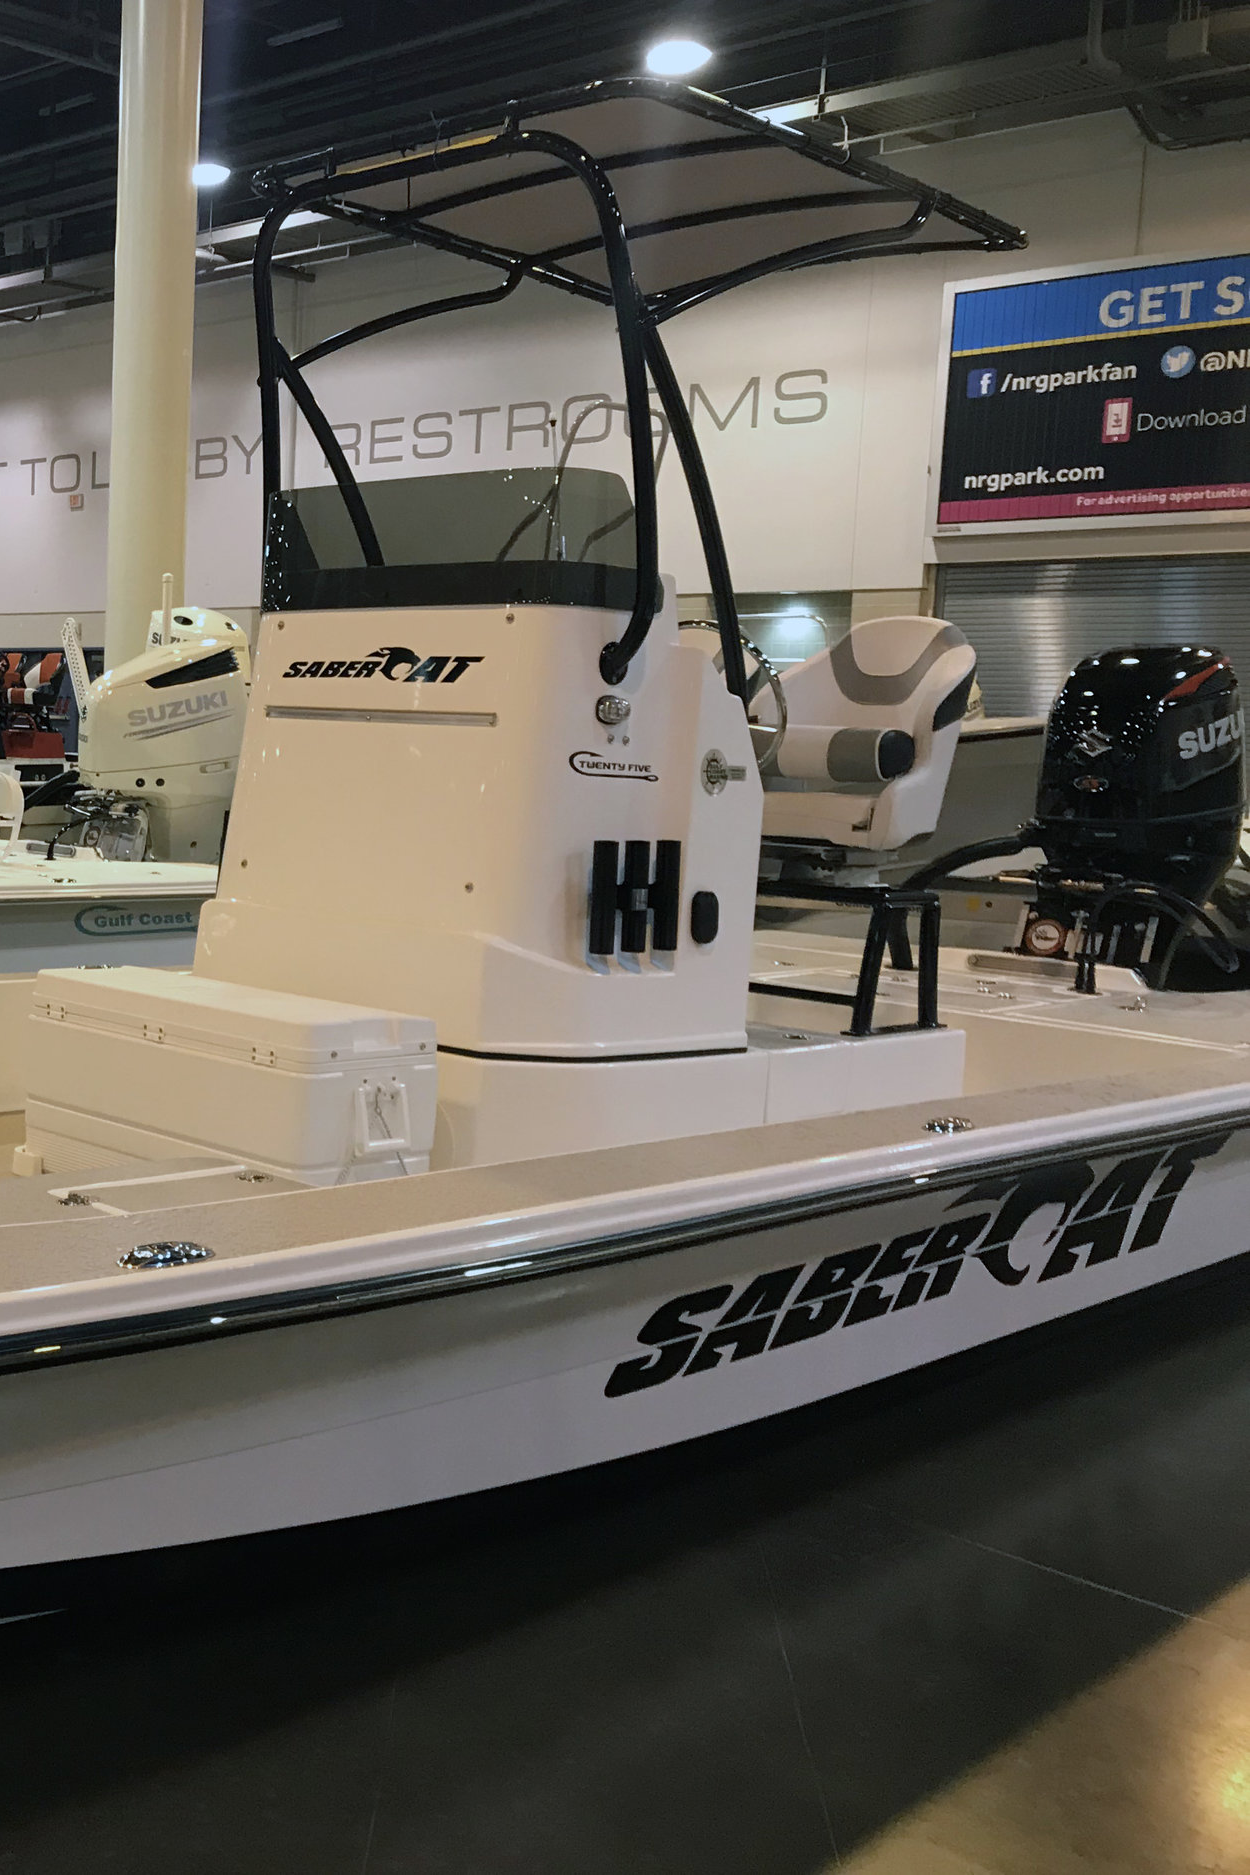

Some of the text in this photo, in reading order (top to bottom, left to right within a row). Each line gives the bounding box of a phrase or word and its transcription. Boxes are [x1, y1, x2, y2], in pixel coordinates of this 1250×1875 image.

[1099, 275, 1250, 328] GET S
[1200, 349, 1250, 372] @N
[1000, 362, 1138, 394] /nrgparkfan
[1137, 404, 1248, 432] Download
[20, 453, 82, 495] TO
[91, 432, 263, 490] LBY
[964, 466, 1105, 492] nrgpark.com
[1076, 496, 1097, 507] For
[1098, 491, 1167, 506] advertising
[282, 647, 486, 684] SABERCAT
[127, 690, 229, 727] SUZUKI
[1178, 708, 1245, 760] SUZU
[579, 760, 652, 773] TWENTY FIVE
[94, 911, 193, 928] Gulf Coast
